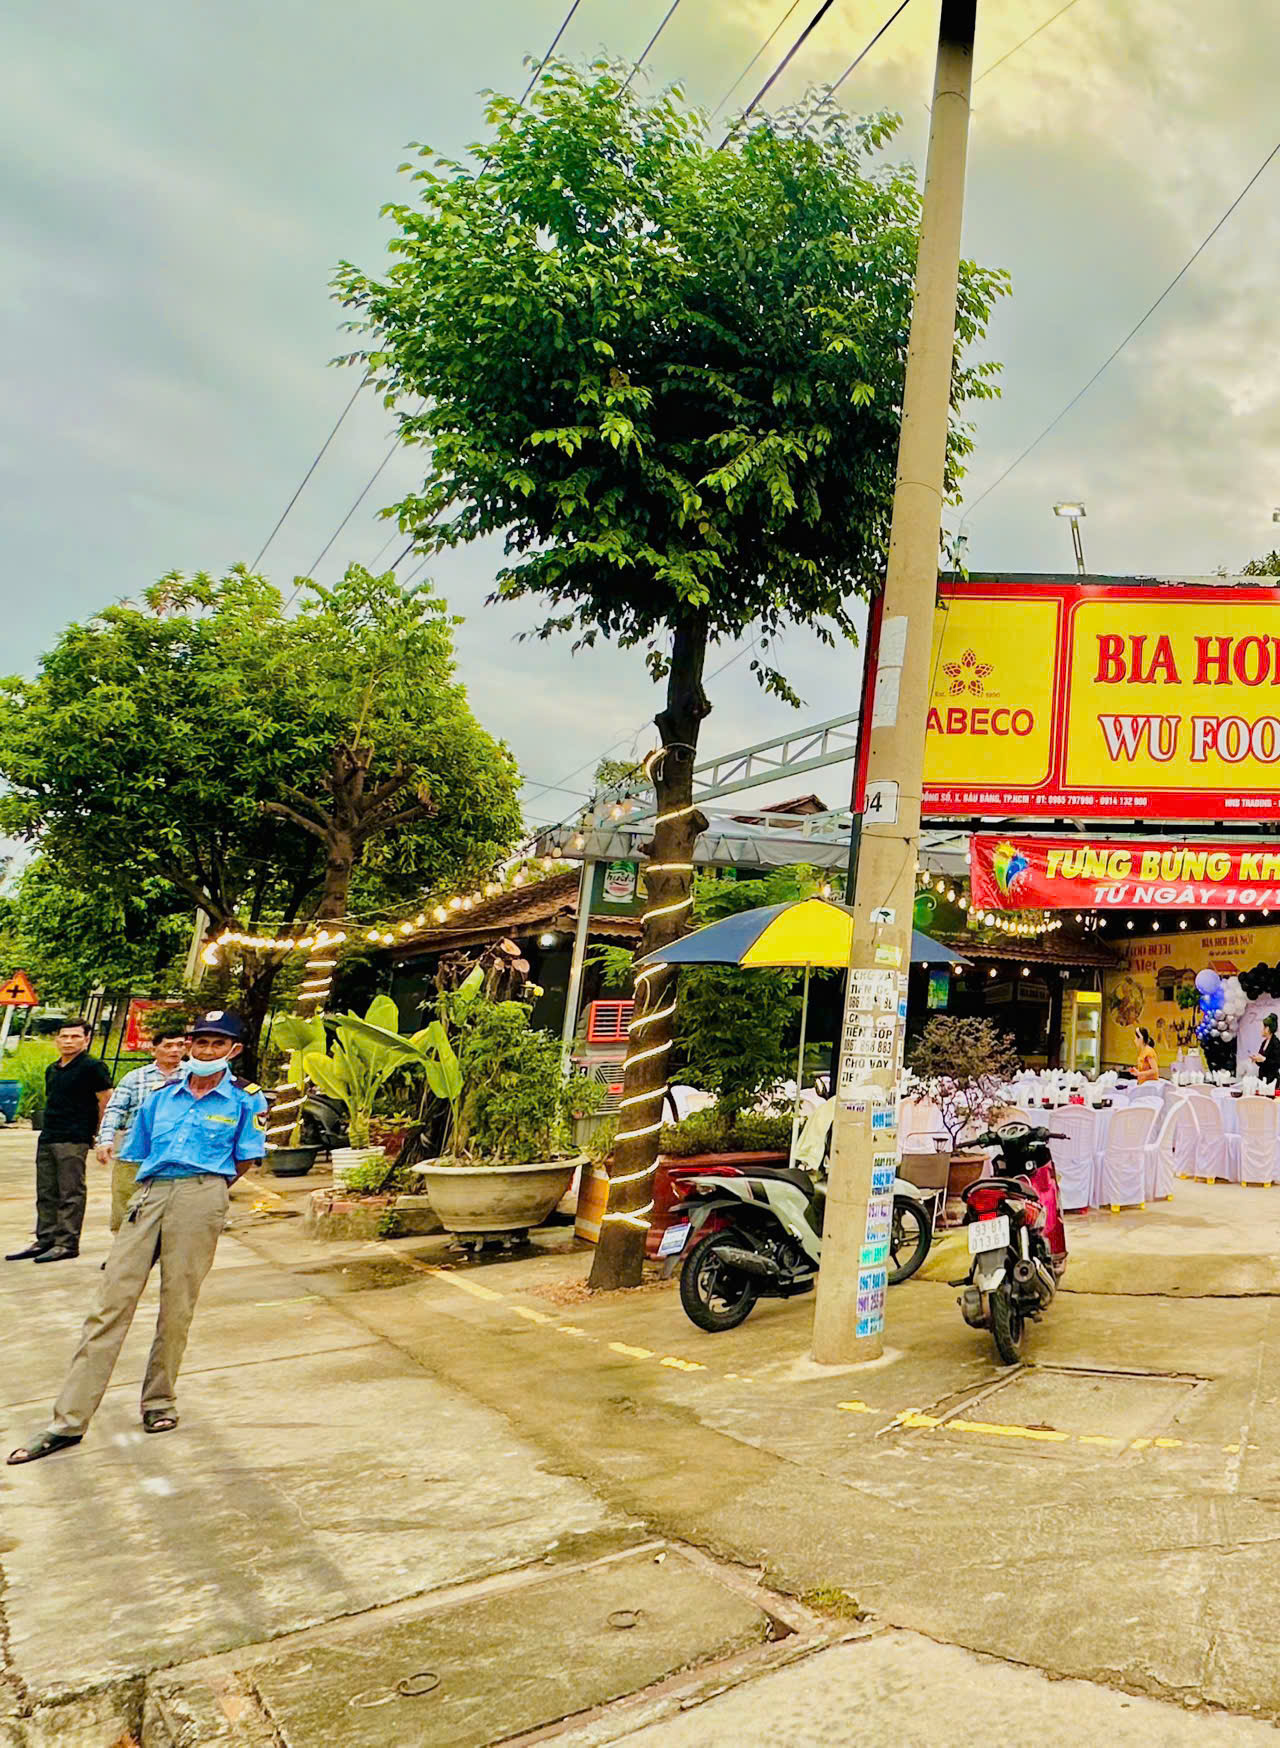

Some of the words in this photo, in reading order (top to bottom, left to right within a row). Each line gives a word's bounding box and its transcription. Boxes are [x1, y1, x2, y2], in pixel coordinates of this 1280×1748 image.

[1094, 633, 1182, 684] BIA
[1097, 713, 1182, 762] WU
[1045, 846, 1133, 879] TƯNG
[1139, 846, 1232, 881] BỪNG
[1093, 883, 1130, 904] TỪ
[1132, 885, 1217, 905] NGÀY
